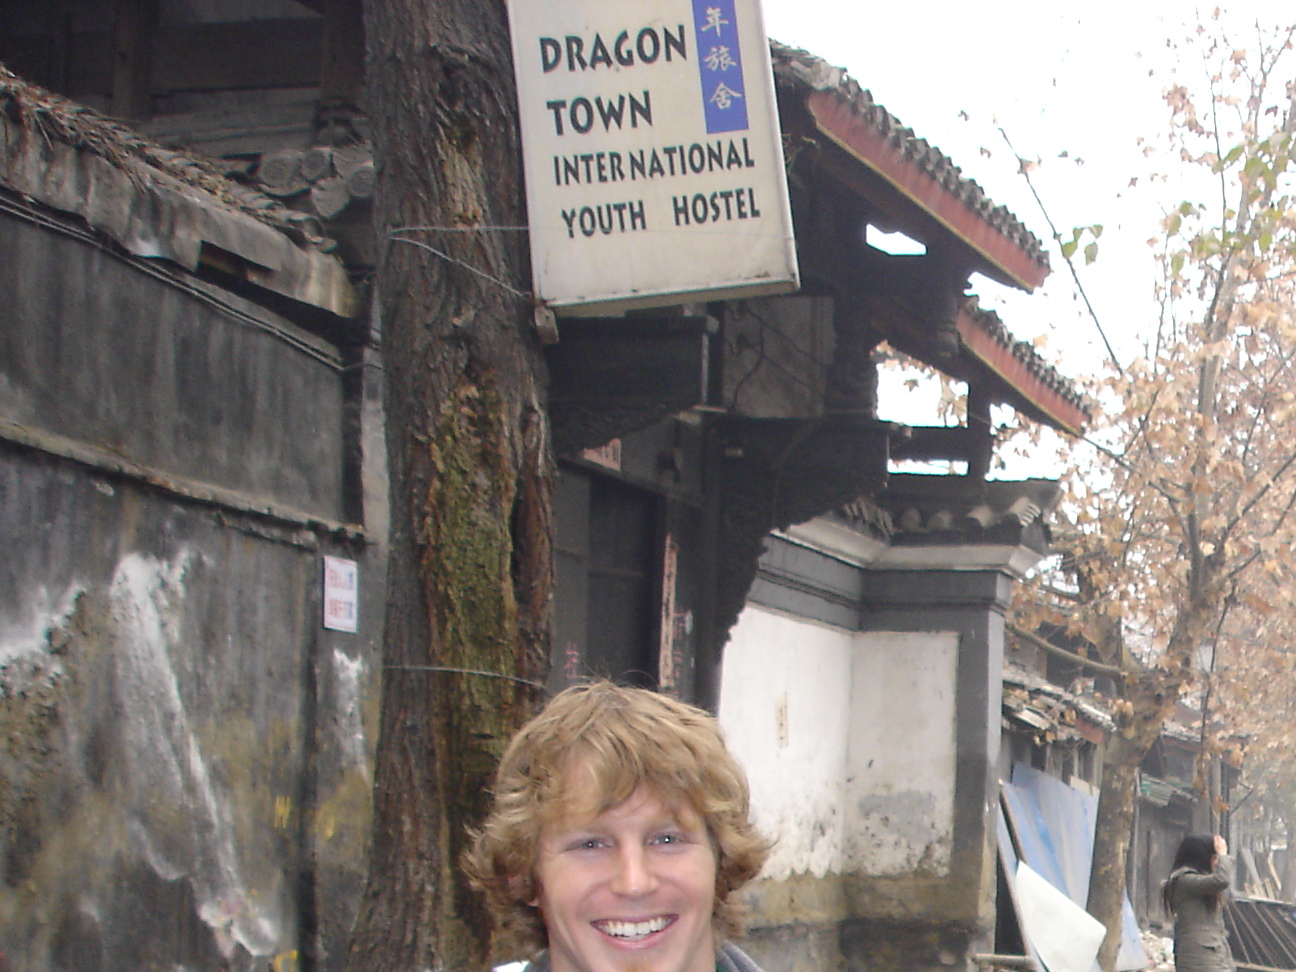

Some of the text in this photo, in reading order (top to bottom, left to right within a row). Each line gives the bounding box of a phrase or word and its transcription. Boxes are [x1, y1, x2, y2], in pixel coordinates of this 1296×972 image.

[539, 24, 687, 73] DRAGON
[701, 6, 743, 110] 年旅舍
[546, 90, 653, 136] TOWN
[553, 137, 755, 186] INTERNATIONAL
[561, 187, 761, 239] YOUTH HOSTEL
